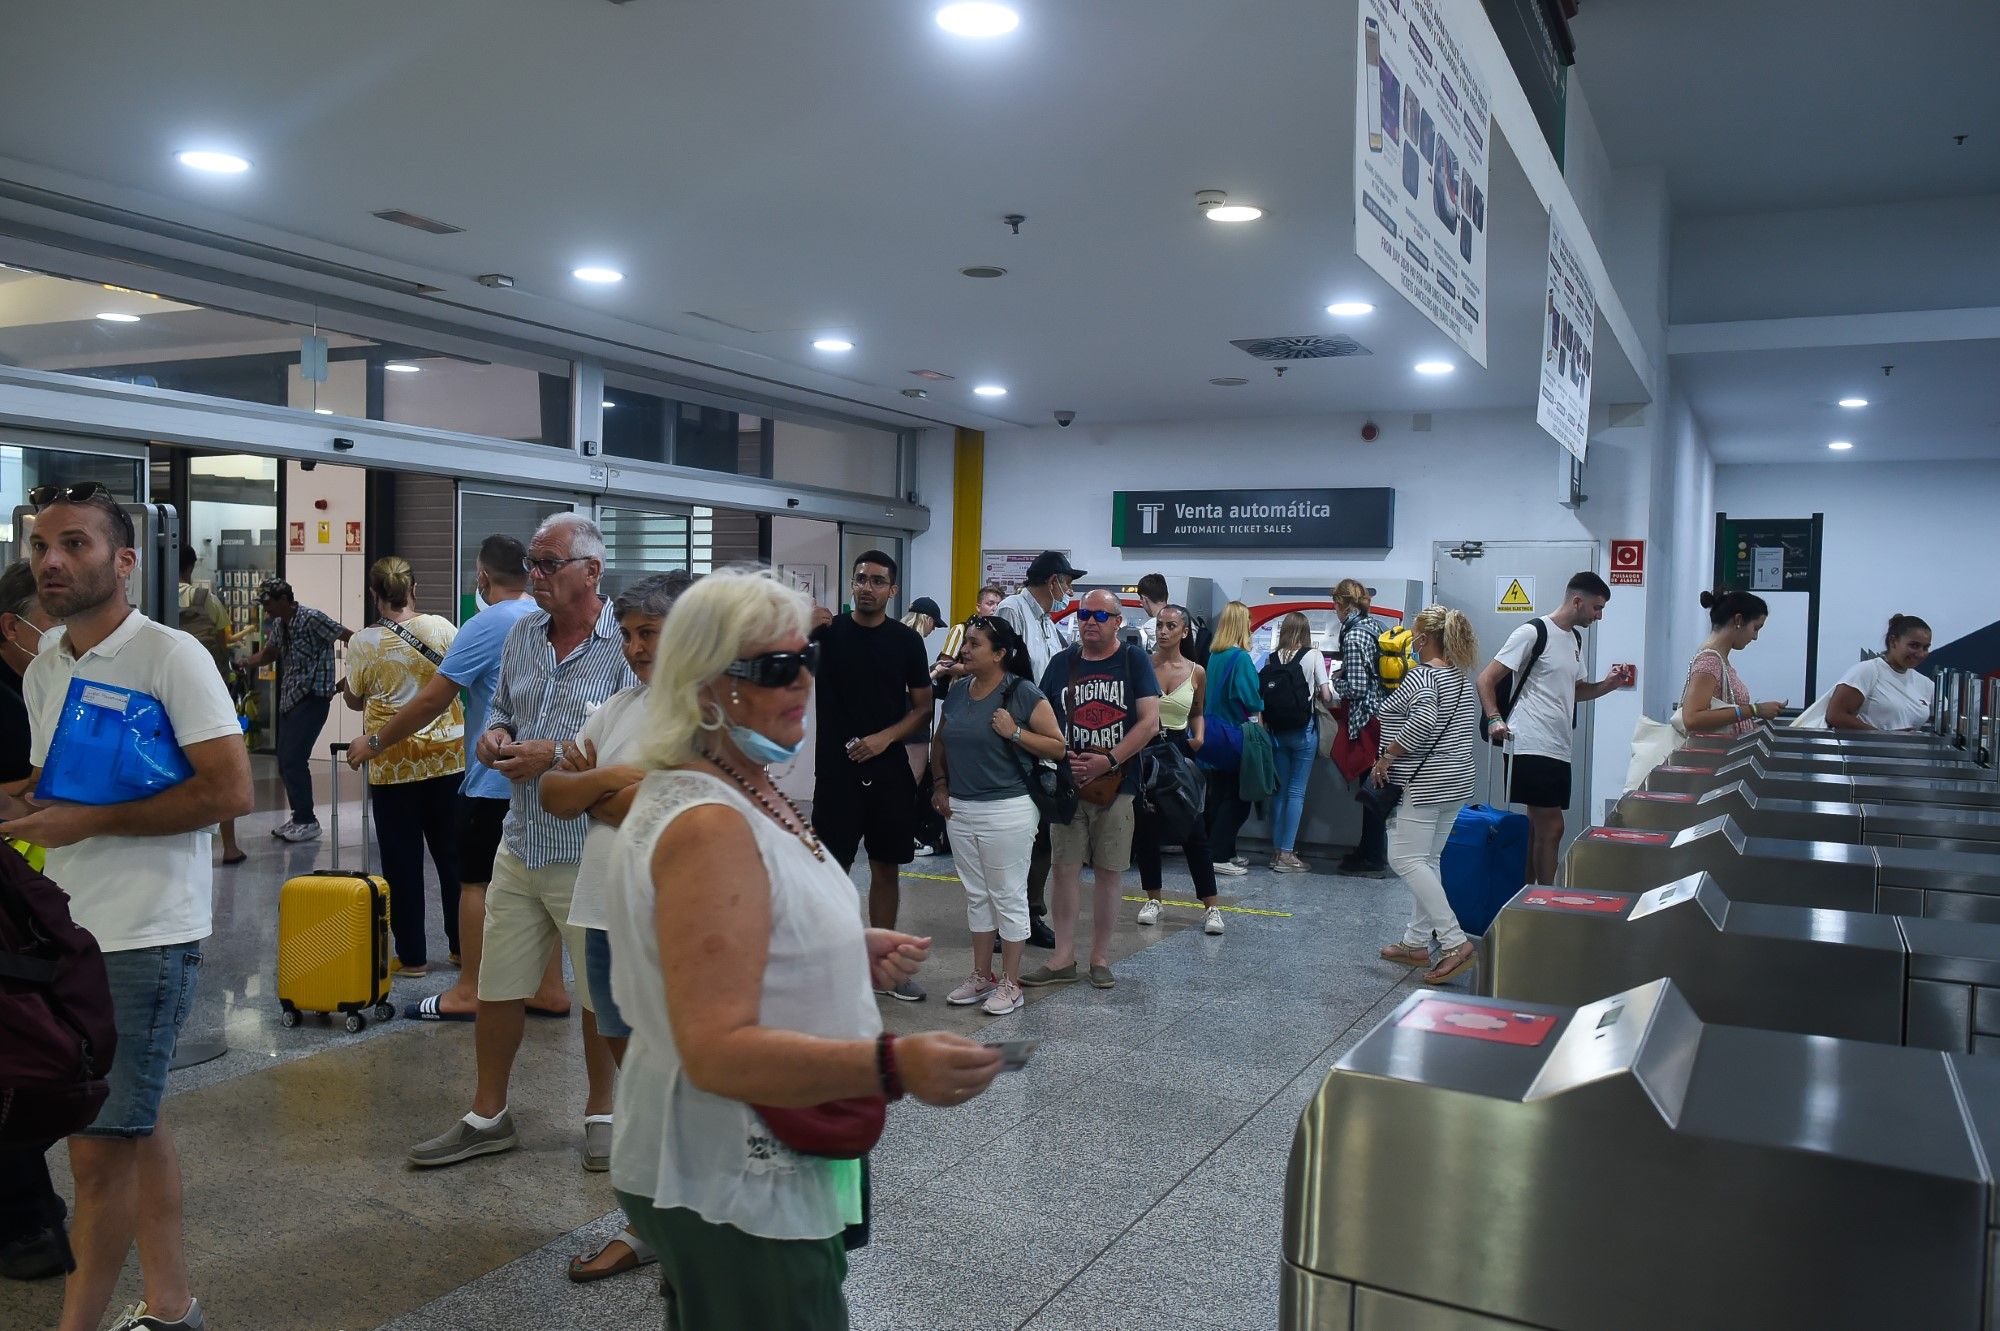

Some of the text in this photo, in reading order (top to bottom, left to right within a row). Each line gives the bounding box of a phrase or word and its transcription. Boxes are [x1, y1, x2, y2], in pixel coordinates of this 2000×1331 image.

[1175, 501, 1331, 519] Venta automática
[1175, 524, 1293, 534] AUTOMATIC TICKET SALES
[400, 630, 424, 651] BIMBA
